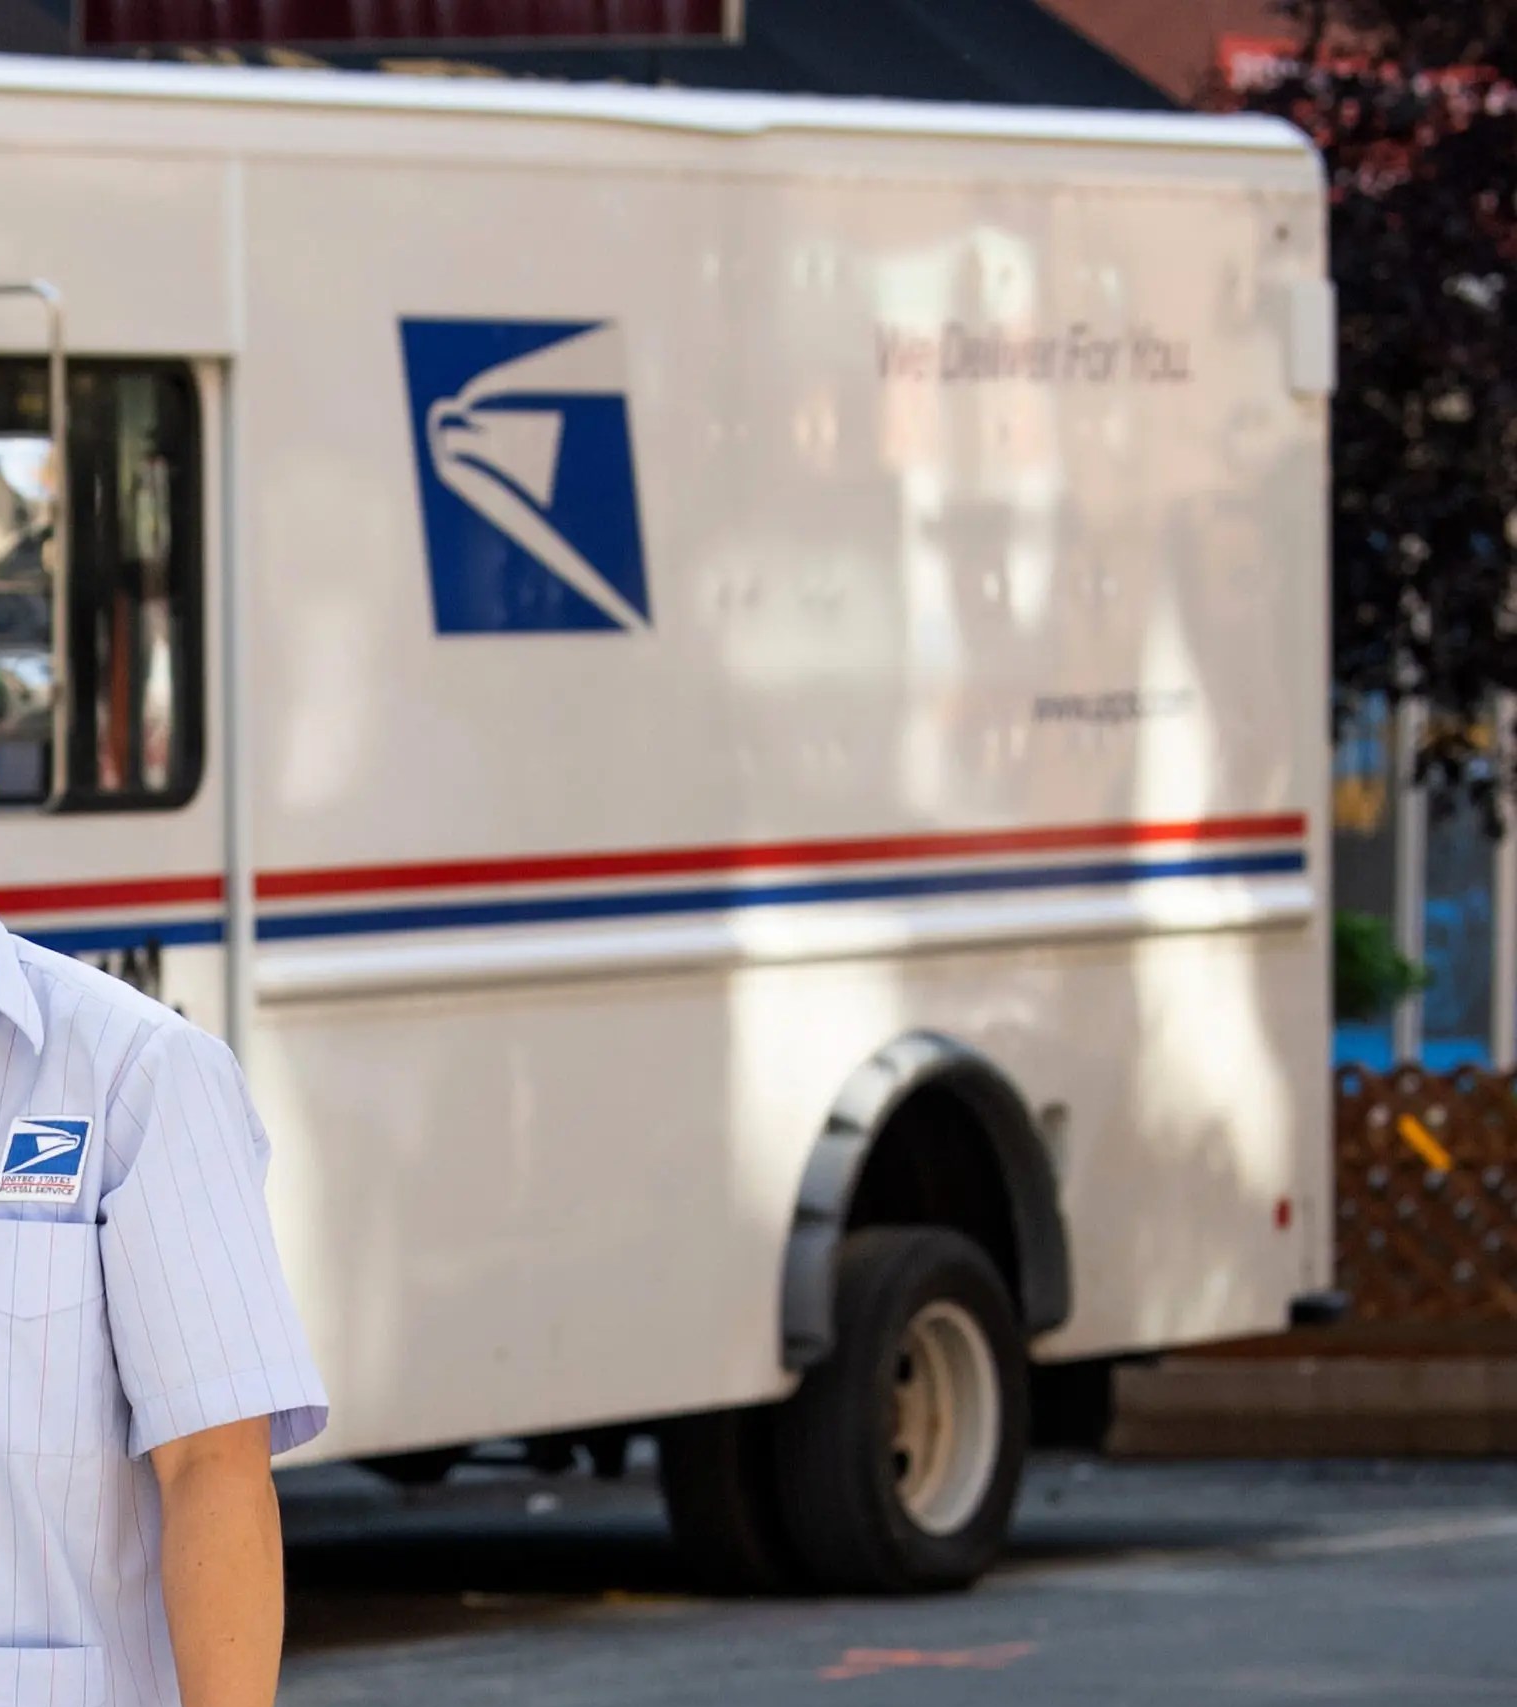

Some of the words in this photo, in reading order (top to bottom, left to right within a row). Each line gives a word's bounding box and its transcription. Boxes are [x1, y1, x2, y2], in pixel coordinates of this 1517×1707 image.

[1, 1175, 34, 1183] UNITED
[39, 1176, 71, 1184] STATES
[0, 1186, 32, 1194] POSTAL
[35, 1187, 75, 1196] SERVICE
